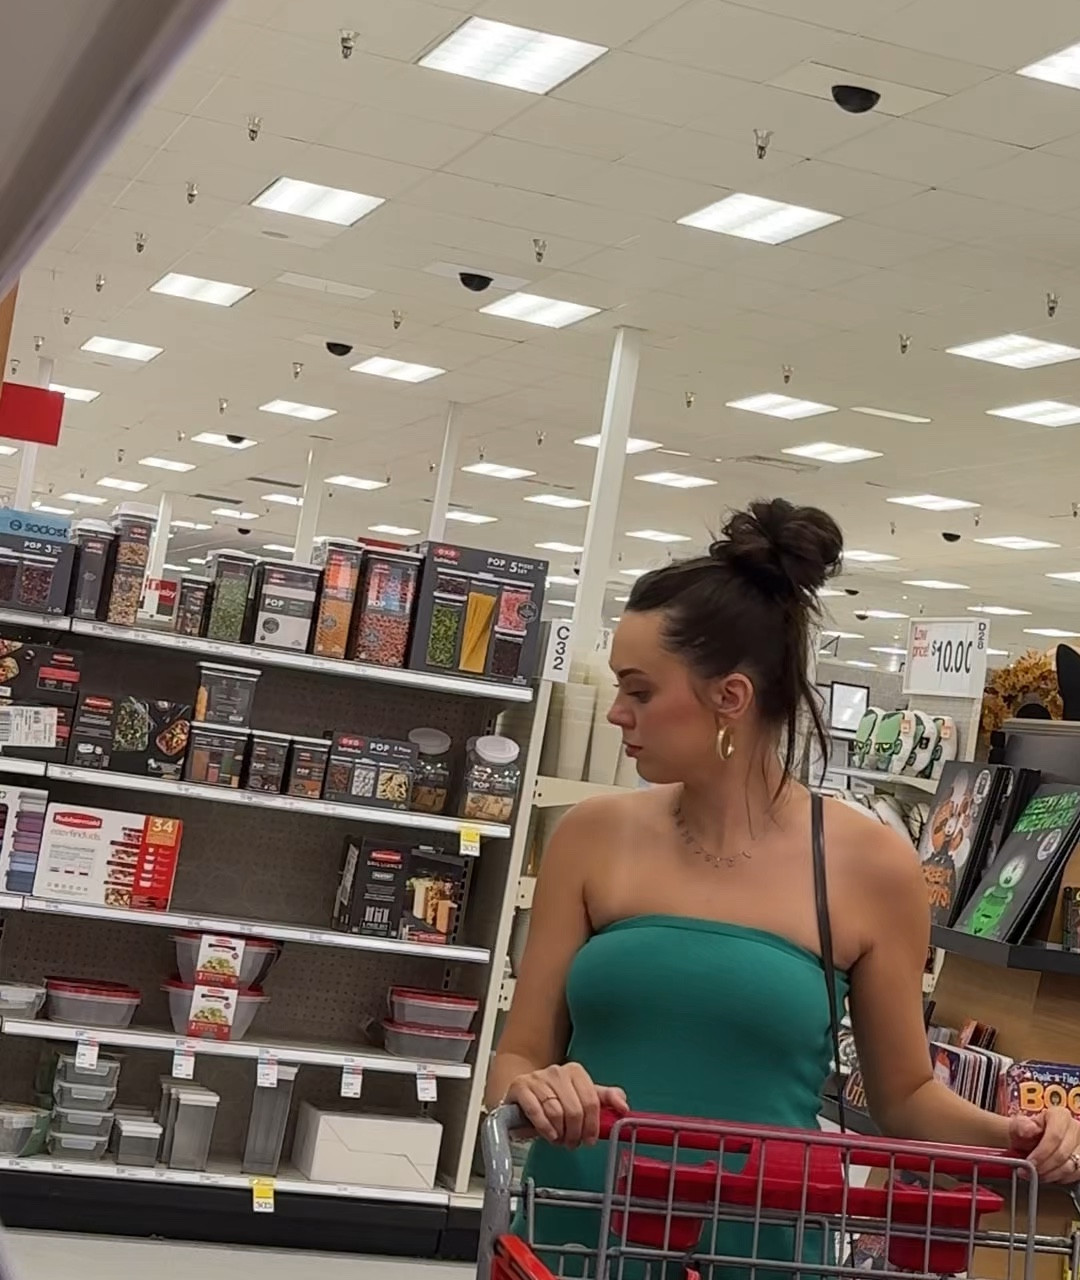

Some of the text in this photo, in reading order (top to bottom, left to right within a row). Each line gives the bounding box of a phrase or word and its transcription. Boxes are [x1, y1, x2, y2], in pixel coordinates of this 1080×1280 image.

[487, 557, 505, 566] POP
[509, 561, 518, 573] 5
[553, 625, 570, 671] C32
[370, 742, 390, 752] POP
[152, 819, 174, 833] 34
